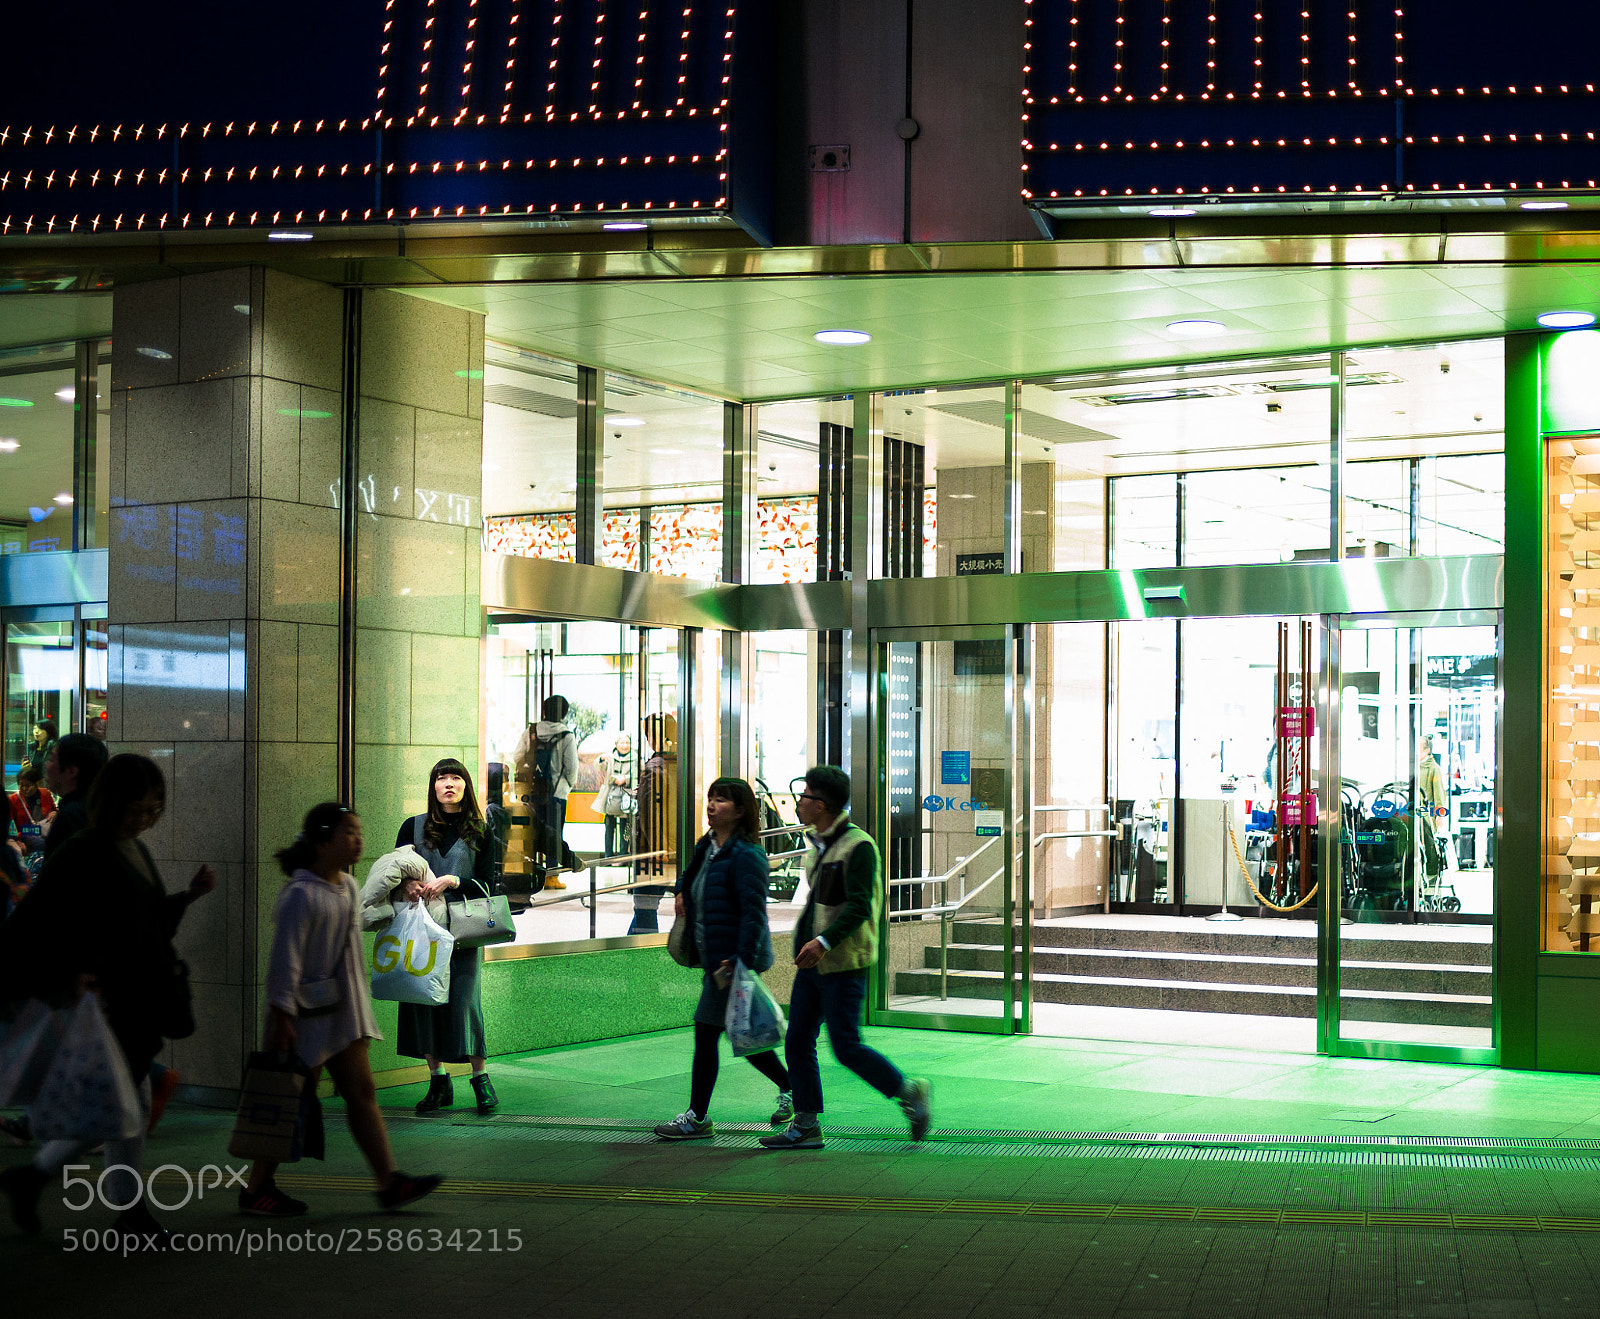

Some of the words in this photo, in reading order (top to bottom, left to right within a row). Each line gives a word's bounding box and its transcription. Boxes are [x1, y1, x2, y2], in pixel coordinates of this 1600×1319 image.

[959, 558, 1005, 571] 大規模小売
[945, 796, 989, 812] Keio
[1398, 801, 1450, 818] Keio
[373, 935, 438, 977] GU
